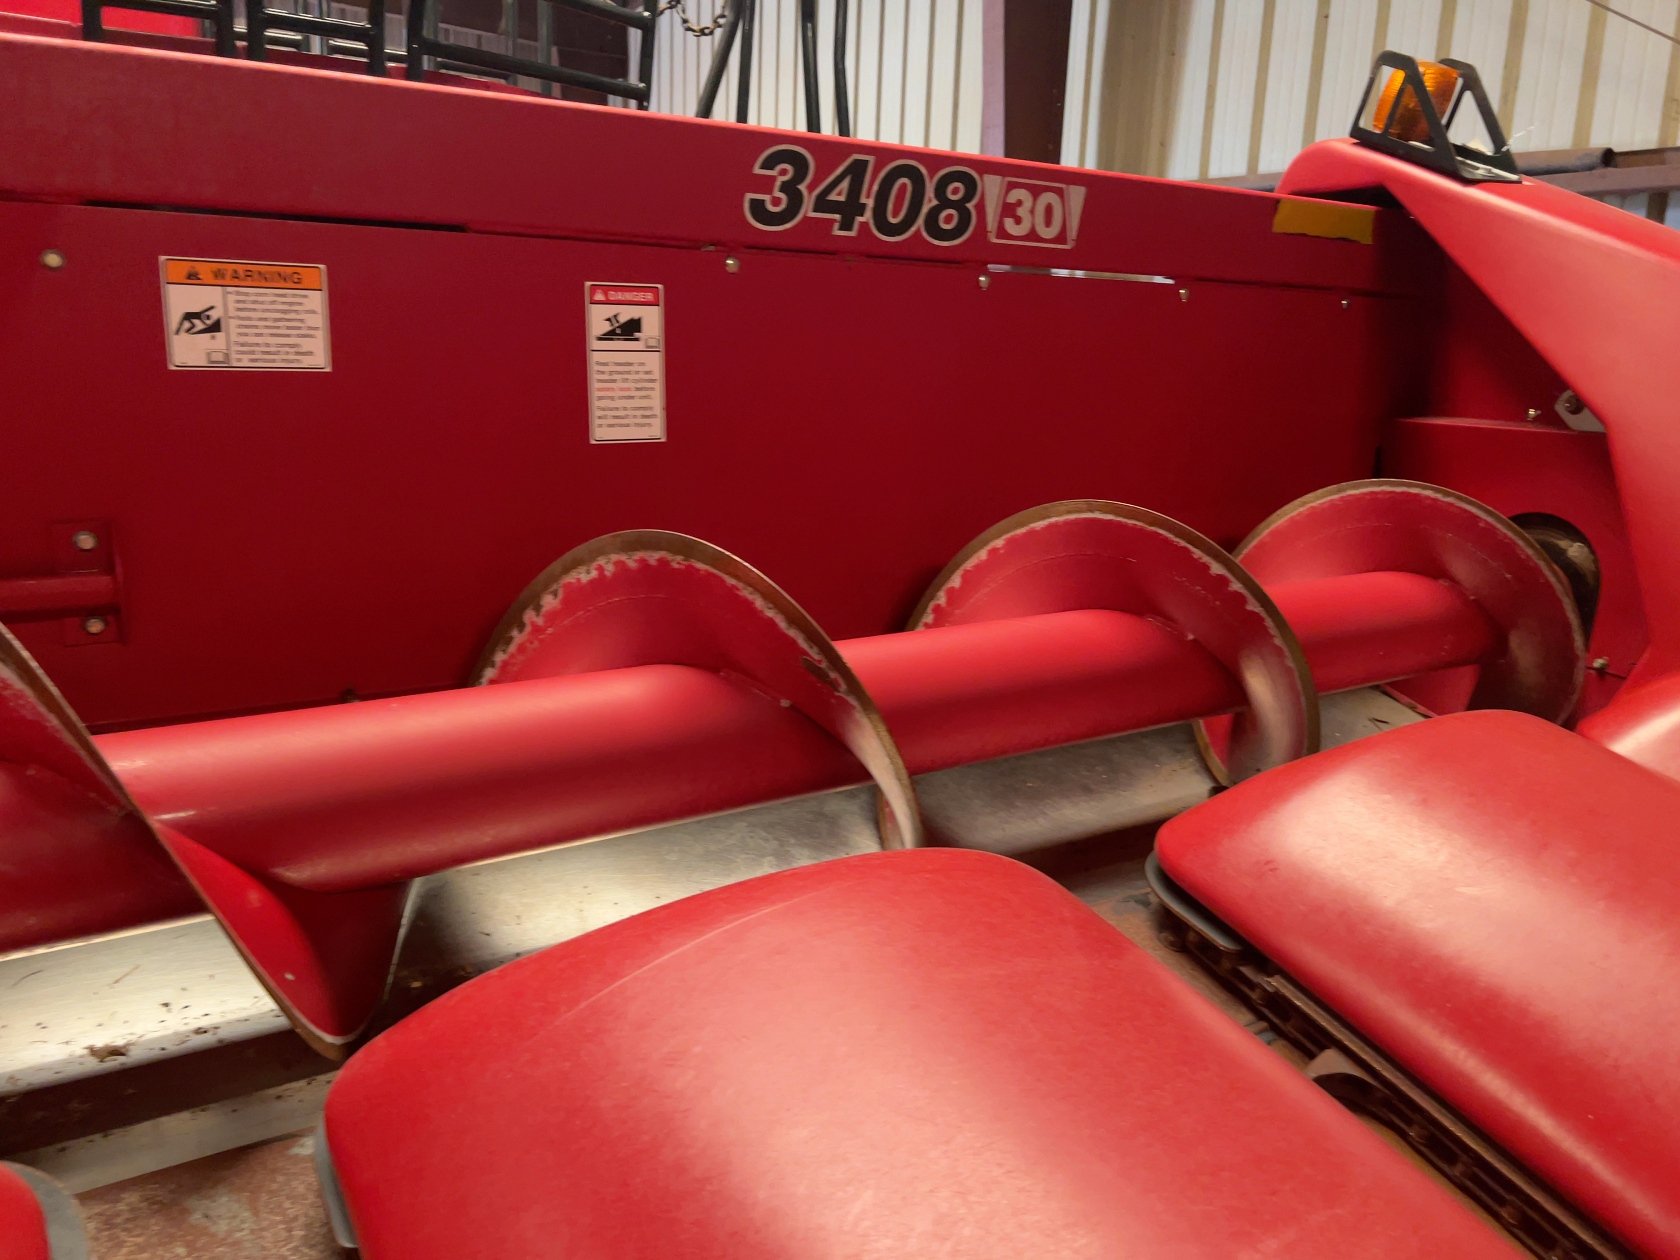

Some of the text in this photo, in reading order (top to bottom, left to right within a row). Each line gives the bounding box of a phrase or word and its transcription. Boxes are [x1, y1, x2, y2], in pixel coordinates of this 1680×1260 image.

[743, 144, 1064, 246] 3408 30
[211, 267, 303, 284] WARNING
[607, 291, 654, 301] DANGER
